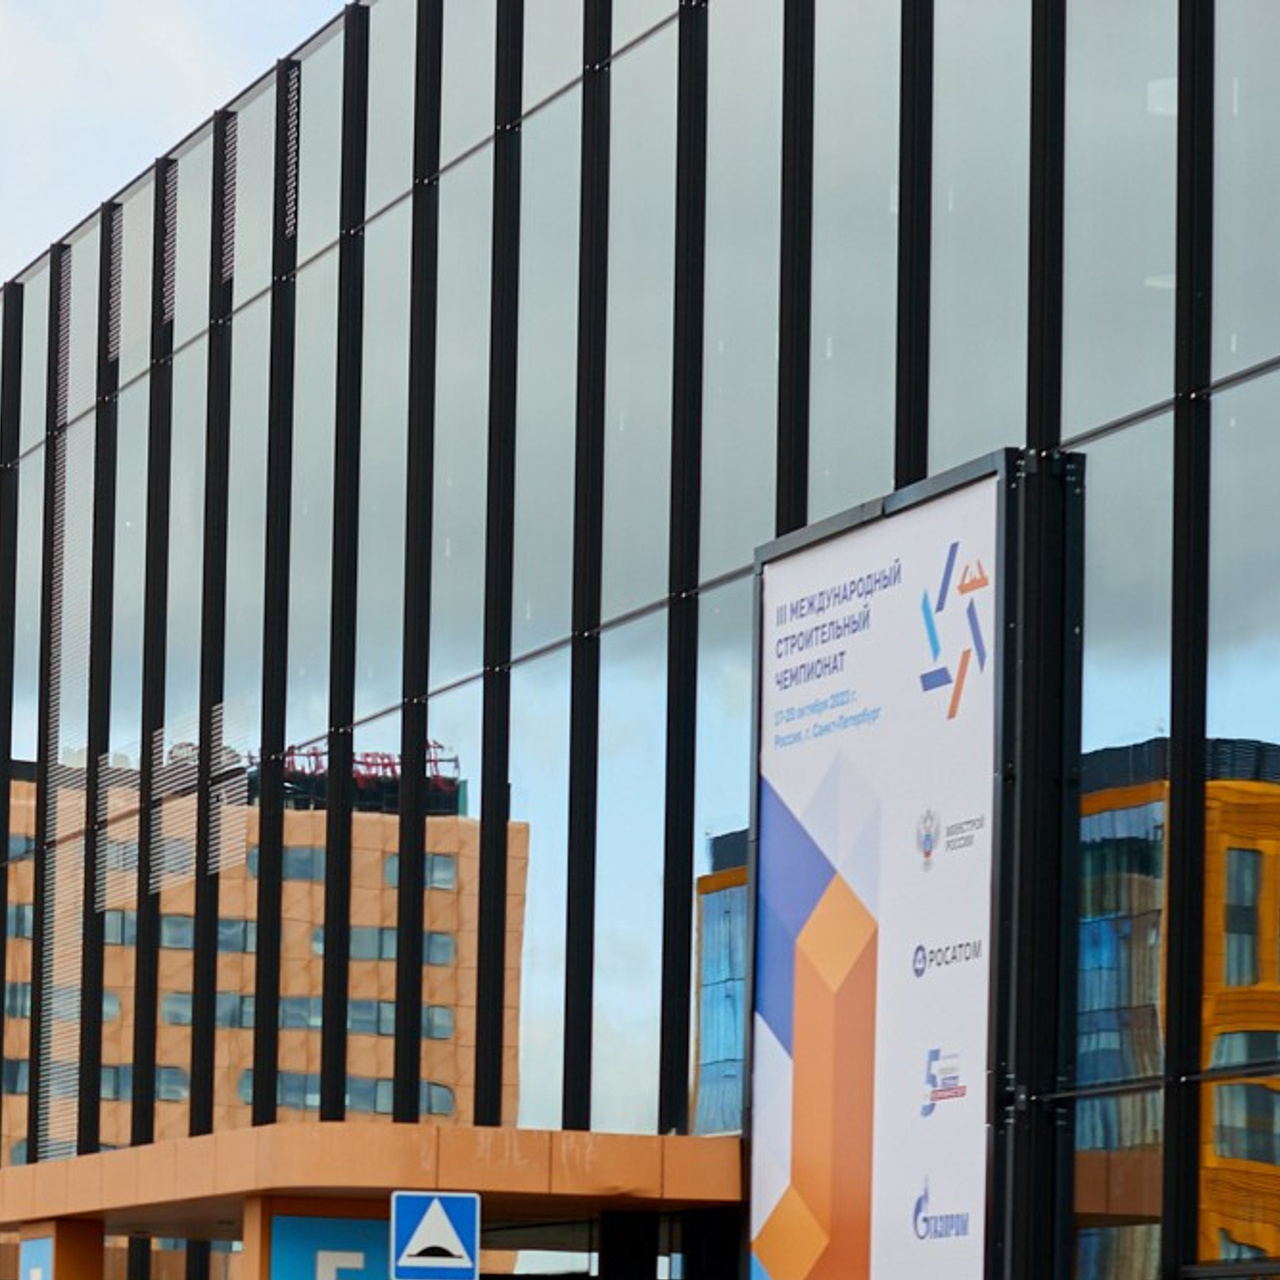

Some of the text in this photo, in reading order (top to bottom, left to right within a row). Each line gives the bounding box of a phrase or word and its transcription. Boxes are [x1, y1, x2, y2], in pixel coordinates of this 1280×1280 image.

[789, 558, 902, 622] МЕЖДУНАРОДНЫЙ
[775, 603, 871, 659] СТРОИТЕЛЬНЫЙ
[774, 650, 846, 691] ЧЕМПИОНАТ
[928, 939, 982, 969] РОСАТОМ
